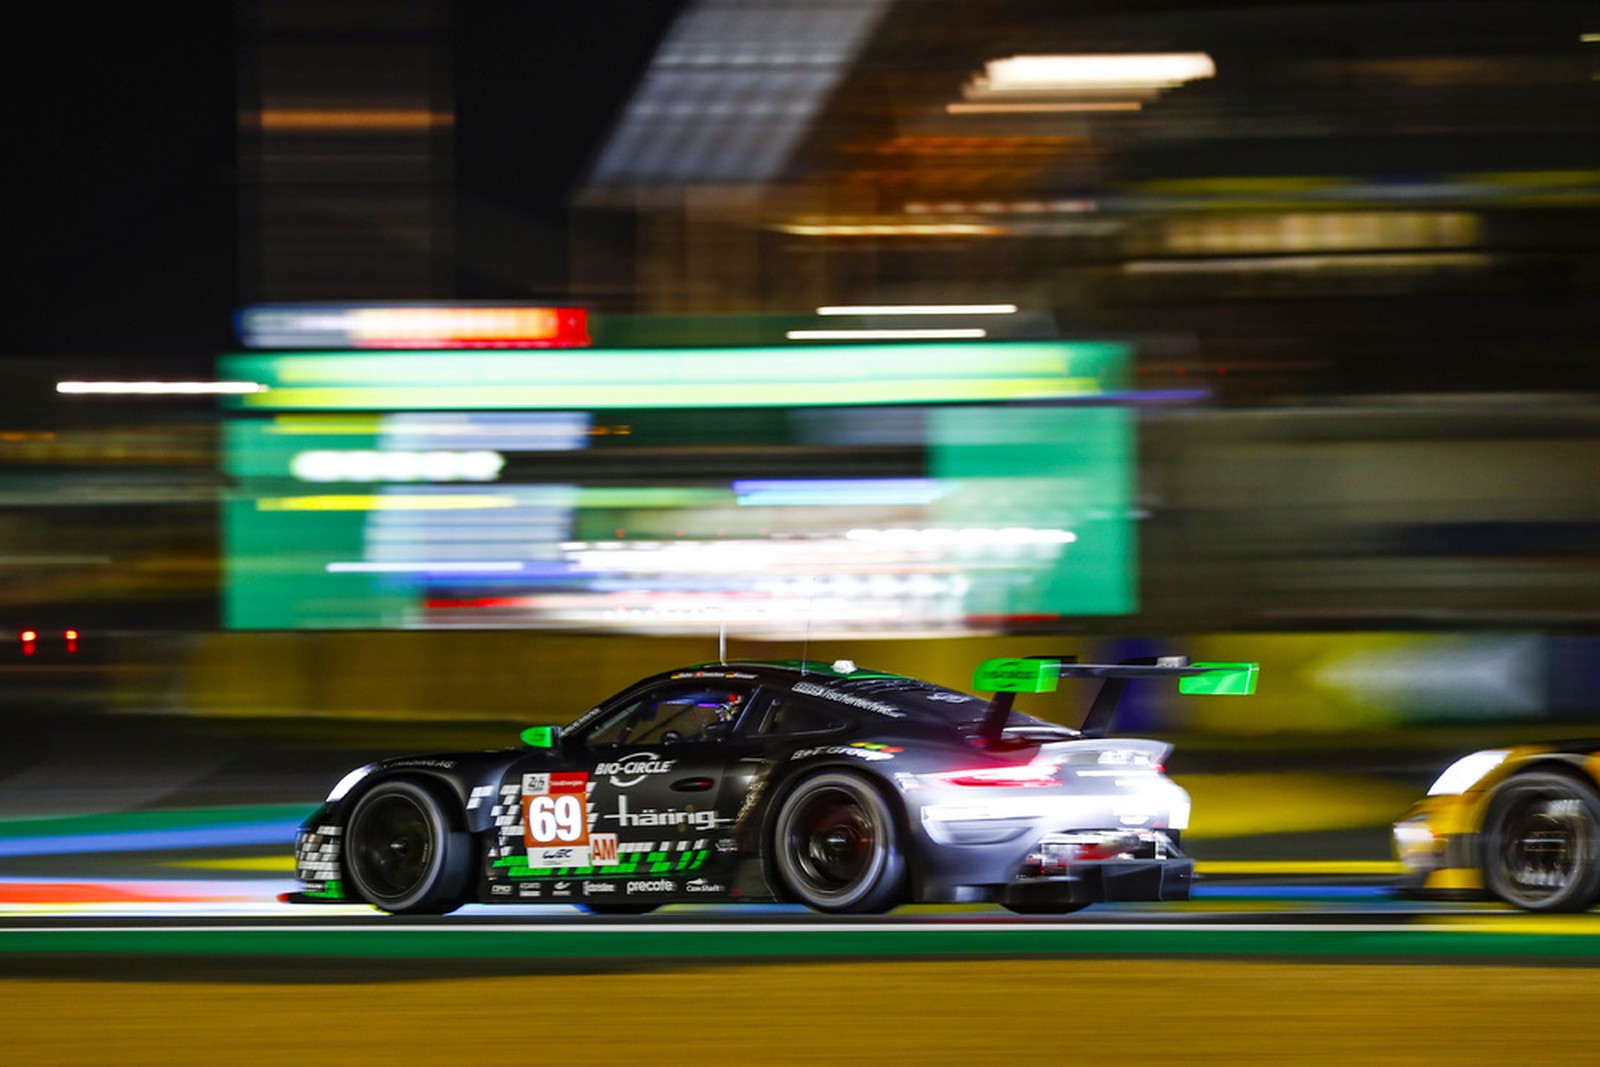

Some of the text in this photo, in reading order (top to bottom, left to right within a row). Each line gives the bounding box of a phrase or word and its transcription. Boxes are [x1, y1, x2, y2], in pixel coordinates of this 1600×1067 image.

[594, 760, 672, 775] BIO-CIRCLE
[529, 795, 583, 843] 69
[617, 795, 722, 831] häring
[592, 839, 617, 861] AM
[626, 879, 675, 895] precote
